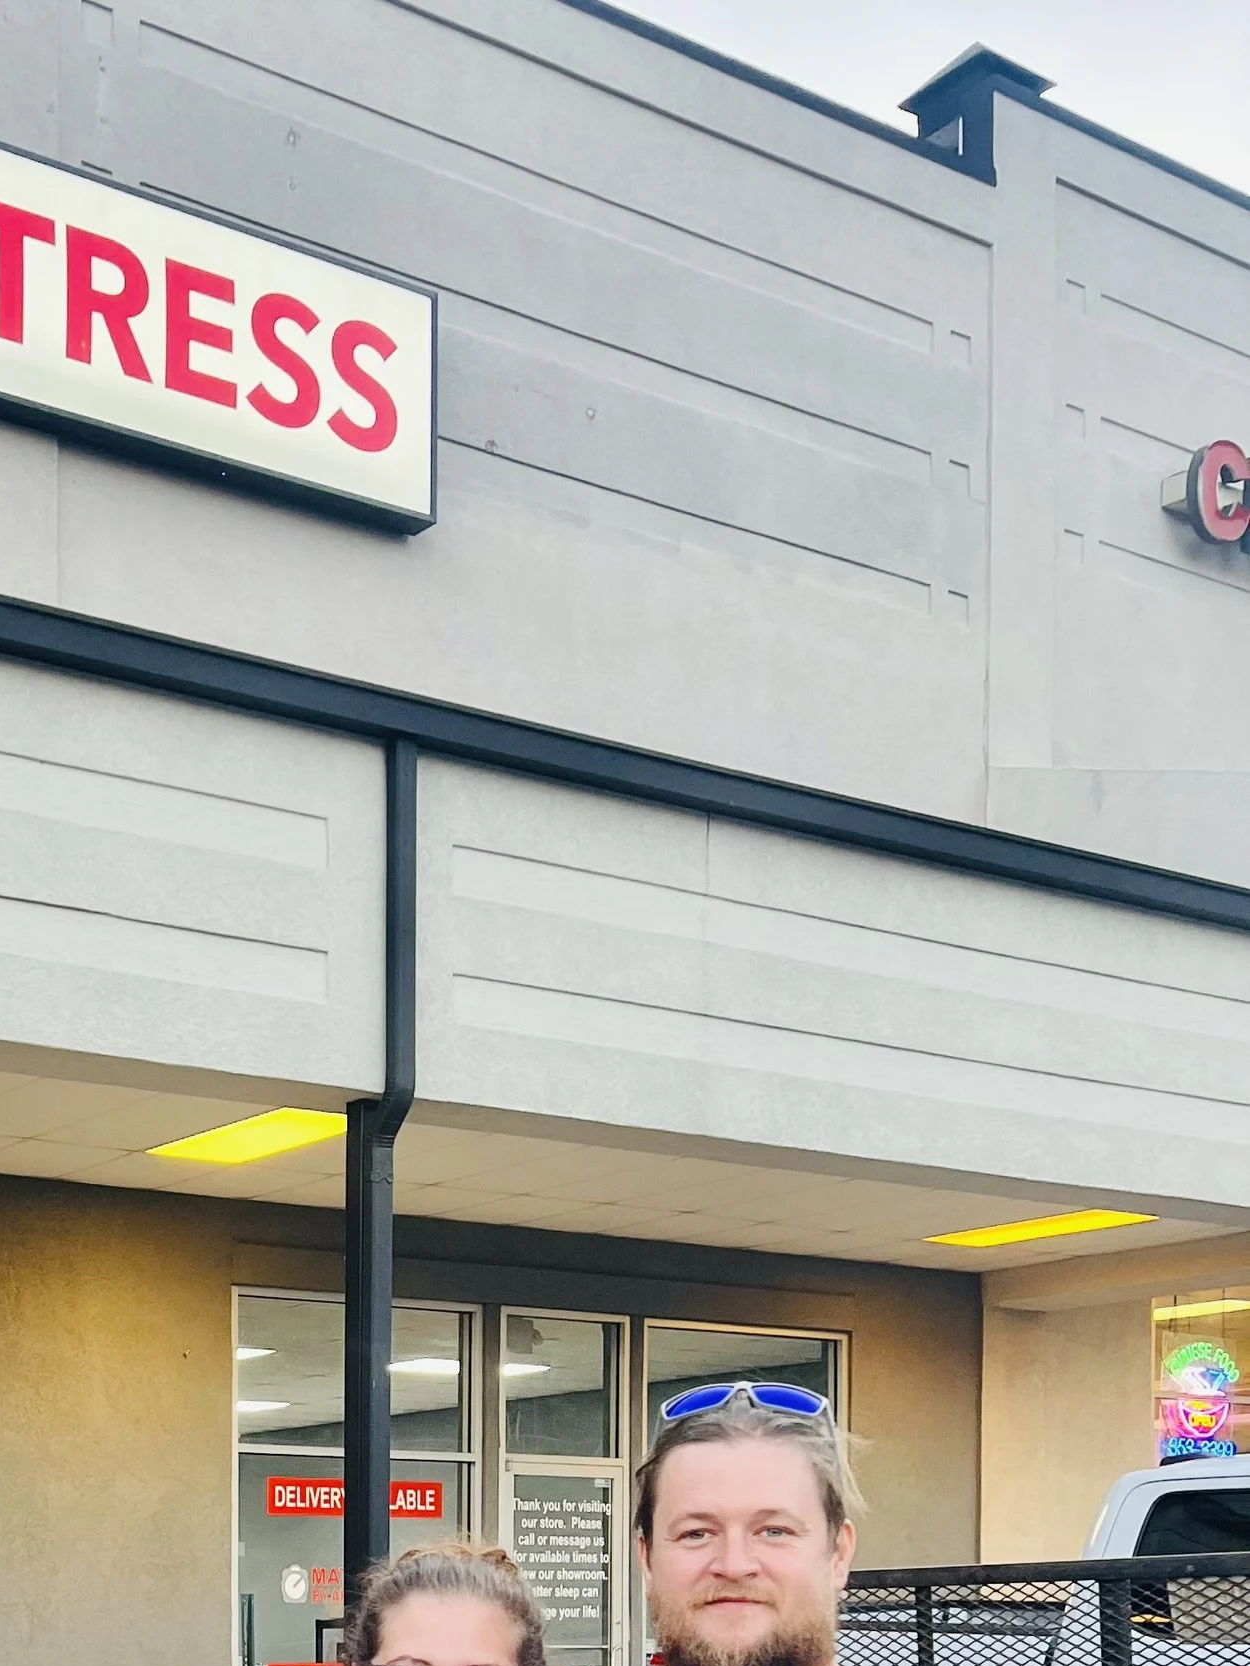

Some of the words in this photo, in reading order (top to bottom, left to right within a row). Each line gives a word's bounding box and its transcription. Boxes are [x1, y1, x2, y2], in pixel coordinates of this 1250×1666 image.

[274, 1485, 345, 1509] DELIVER
[513, 1497, 541, 1511] Thank
[543, 1501, 560, 1514] you
[563, 1499, 576, 1511] for
[578, 1500, 611, 1515] visiting
[521, 1518, 538, 1528] our
[540, 1517, 566, 1529] store.
[572, 1516, 602, 1529] Please
[518, 1533, 535, 1545] call
[537, 1535, 548, 1545] or
[550, 1535, 591, 1548] message
[593, 1536, 605, 1546] us
[514, 1550, 526, 1562] for
[529, 1550, 570, 1563] available
[573, 1551, 598, 1563] times
[600, 1552, 609, 1563] to
[520, 1568, 536, 1580] iew
[539, 1570, 554, 1580] our
[557, 1568, 608, 1581] showroom.
[555, 1585, 580, 1600] sleep
[582, 1587, 599, 1597] can
[559, 1607, 580, 1620] your
